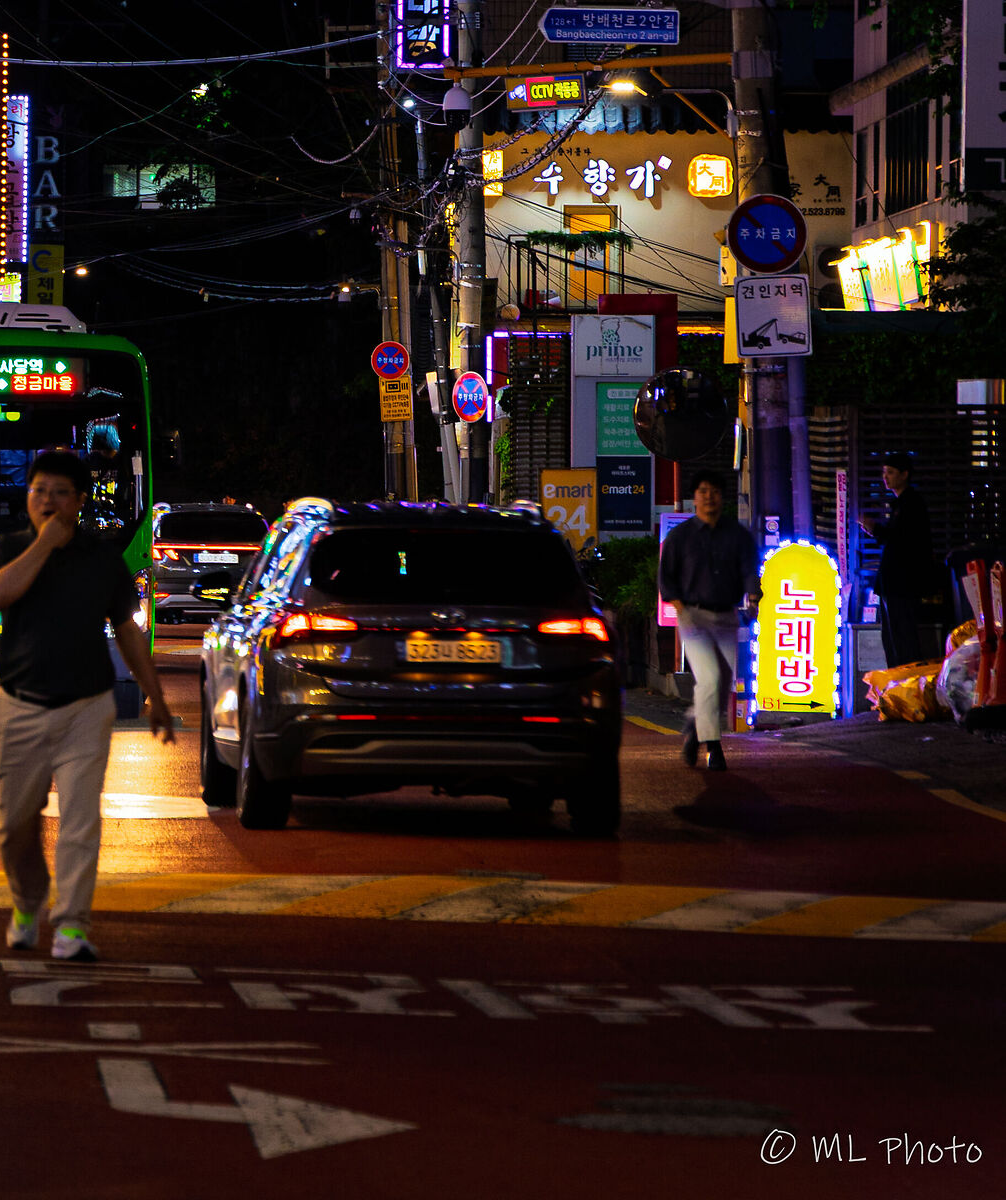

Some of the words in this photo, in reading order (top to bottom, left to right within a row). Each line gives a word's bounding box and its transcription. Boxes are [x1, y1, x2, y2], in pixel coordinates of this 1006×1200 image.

[556, 29, 637, 41] Bangbaecheon-ro
[530, 85, 554, 100] CCTV
[34, 136, 61, 232] BAR
[533, 160, 661, 199] 수향가
[739, 226, 796, 241] 주차금지
[741, 283, 804, 300] 견인지역
[586, 345, 644, 361] prime
[0, 358, 44, 374] 사당역
[13, 375, 73, 391] 정금마을
[543, 483, 594, 499] emart
[547, 505, 590, 538] 24
[775, 579, 819, 697] 노래방
[762, 698, 782, 710] B1
